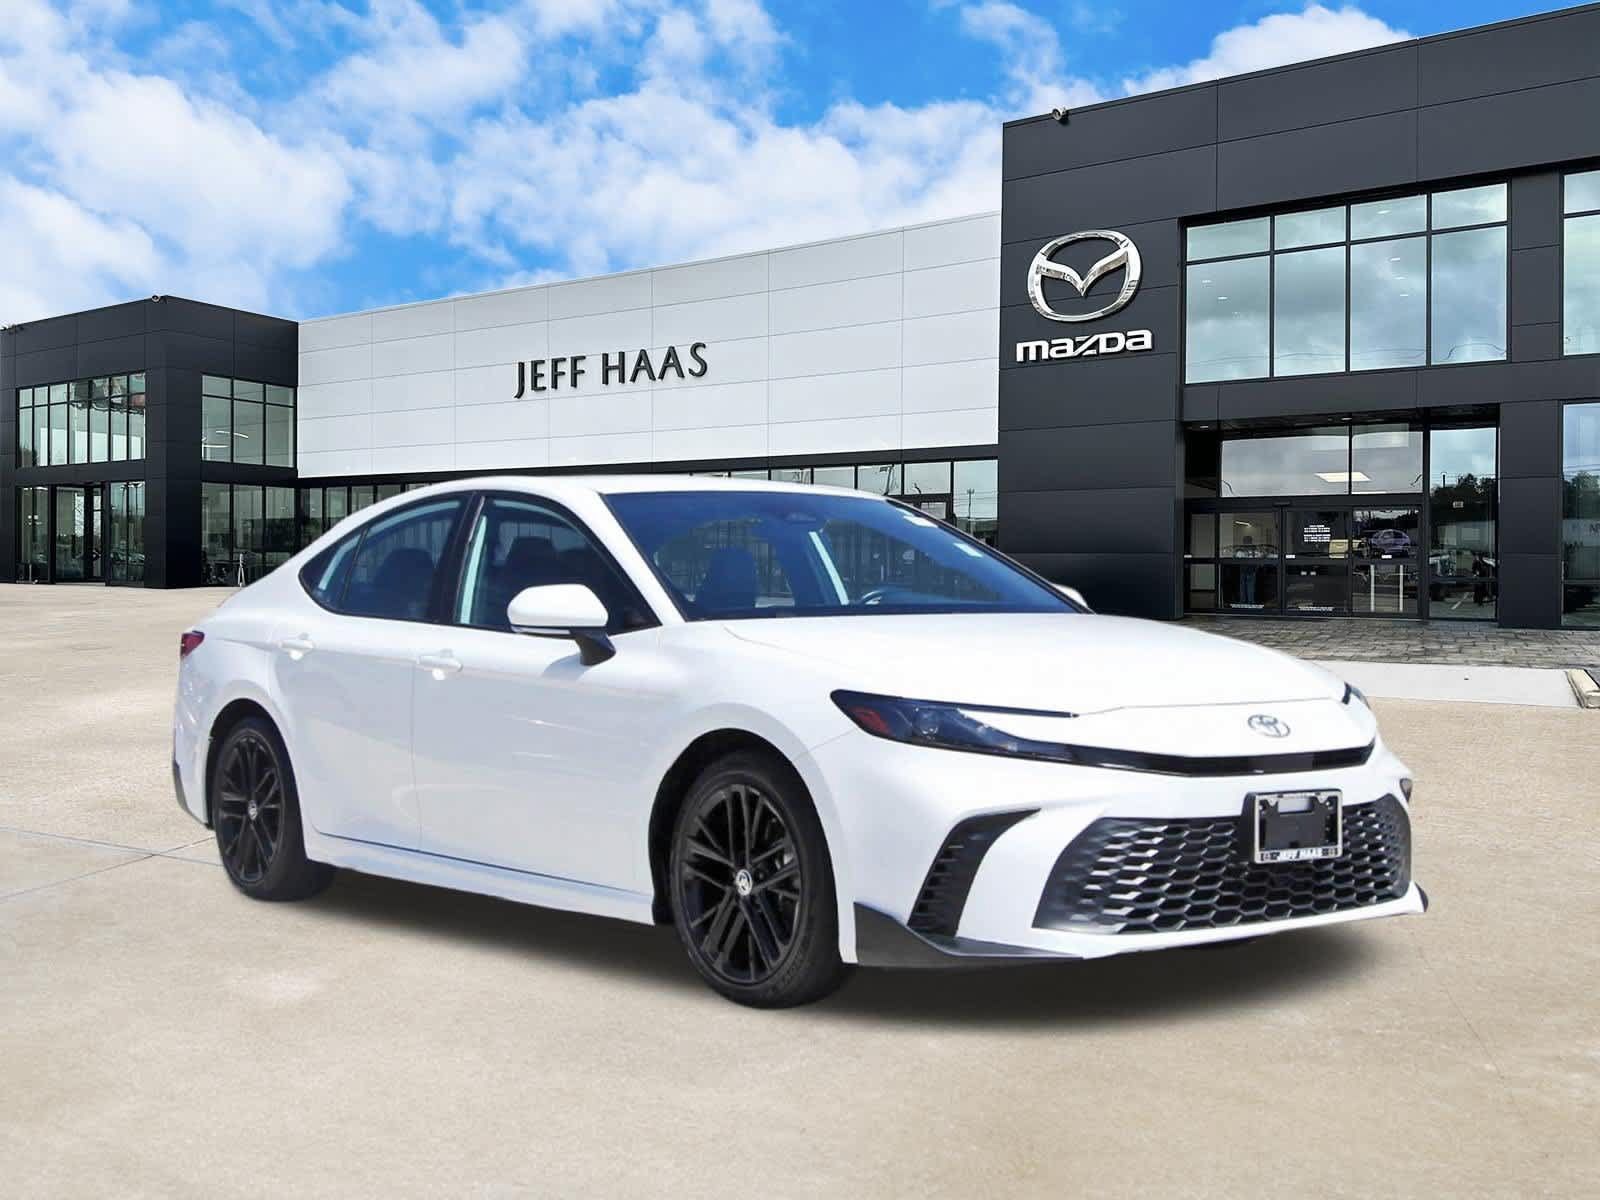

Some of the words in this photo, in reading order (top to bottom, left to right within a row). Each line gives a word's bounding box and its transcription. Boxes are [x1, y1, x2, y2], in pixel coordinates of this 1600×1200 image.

[1016, 329, 1153, 362] mazda
[514, 355, 587, 399] JEFF
[601, 342, 708, 386] HAAS
